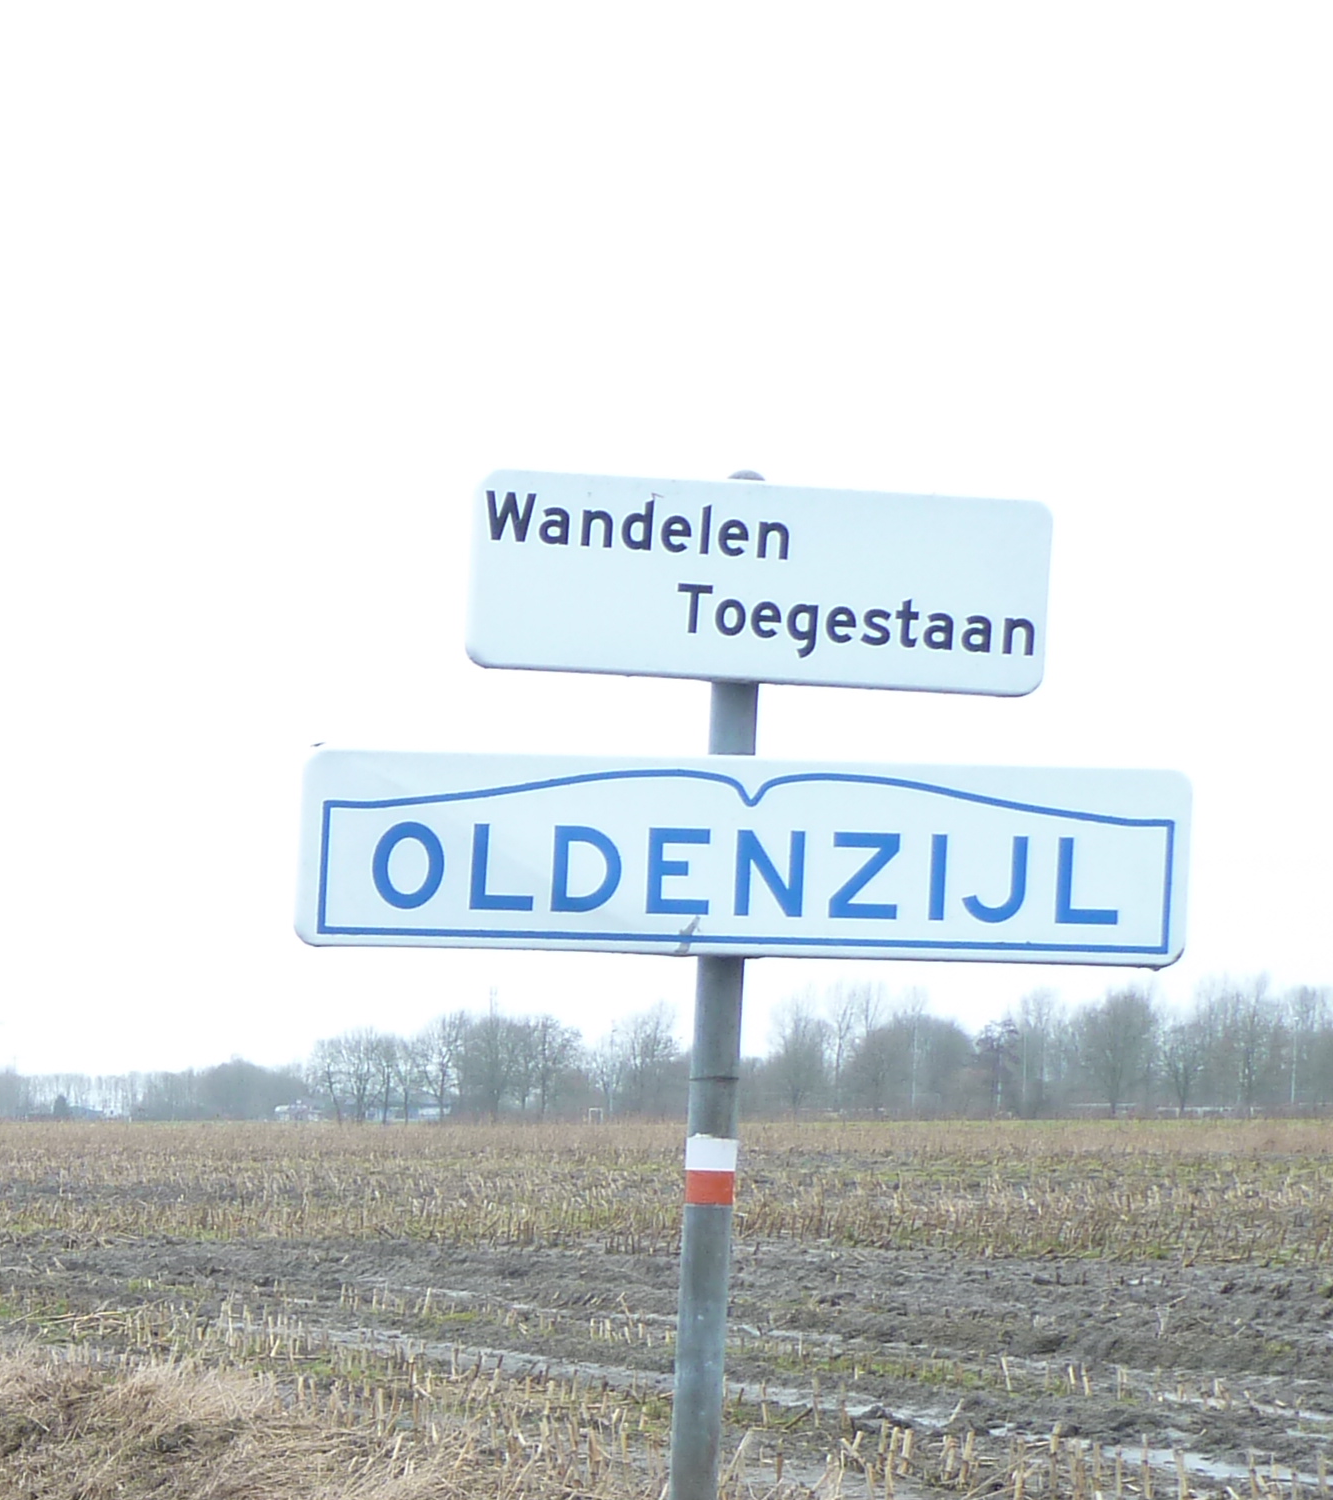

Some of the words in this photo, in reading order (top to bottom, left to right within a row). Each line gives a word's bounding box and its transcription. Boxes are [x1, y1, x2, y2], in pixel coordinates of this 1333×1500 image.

[486, 490, 790, 560] Wandelen
[678, 583, 1035, 658] Toegestaan
[372, 821, 1119, 925] OLDENZIJL
